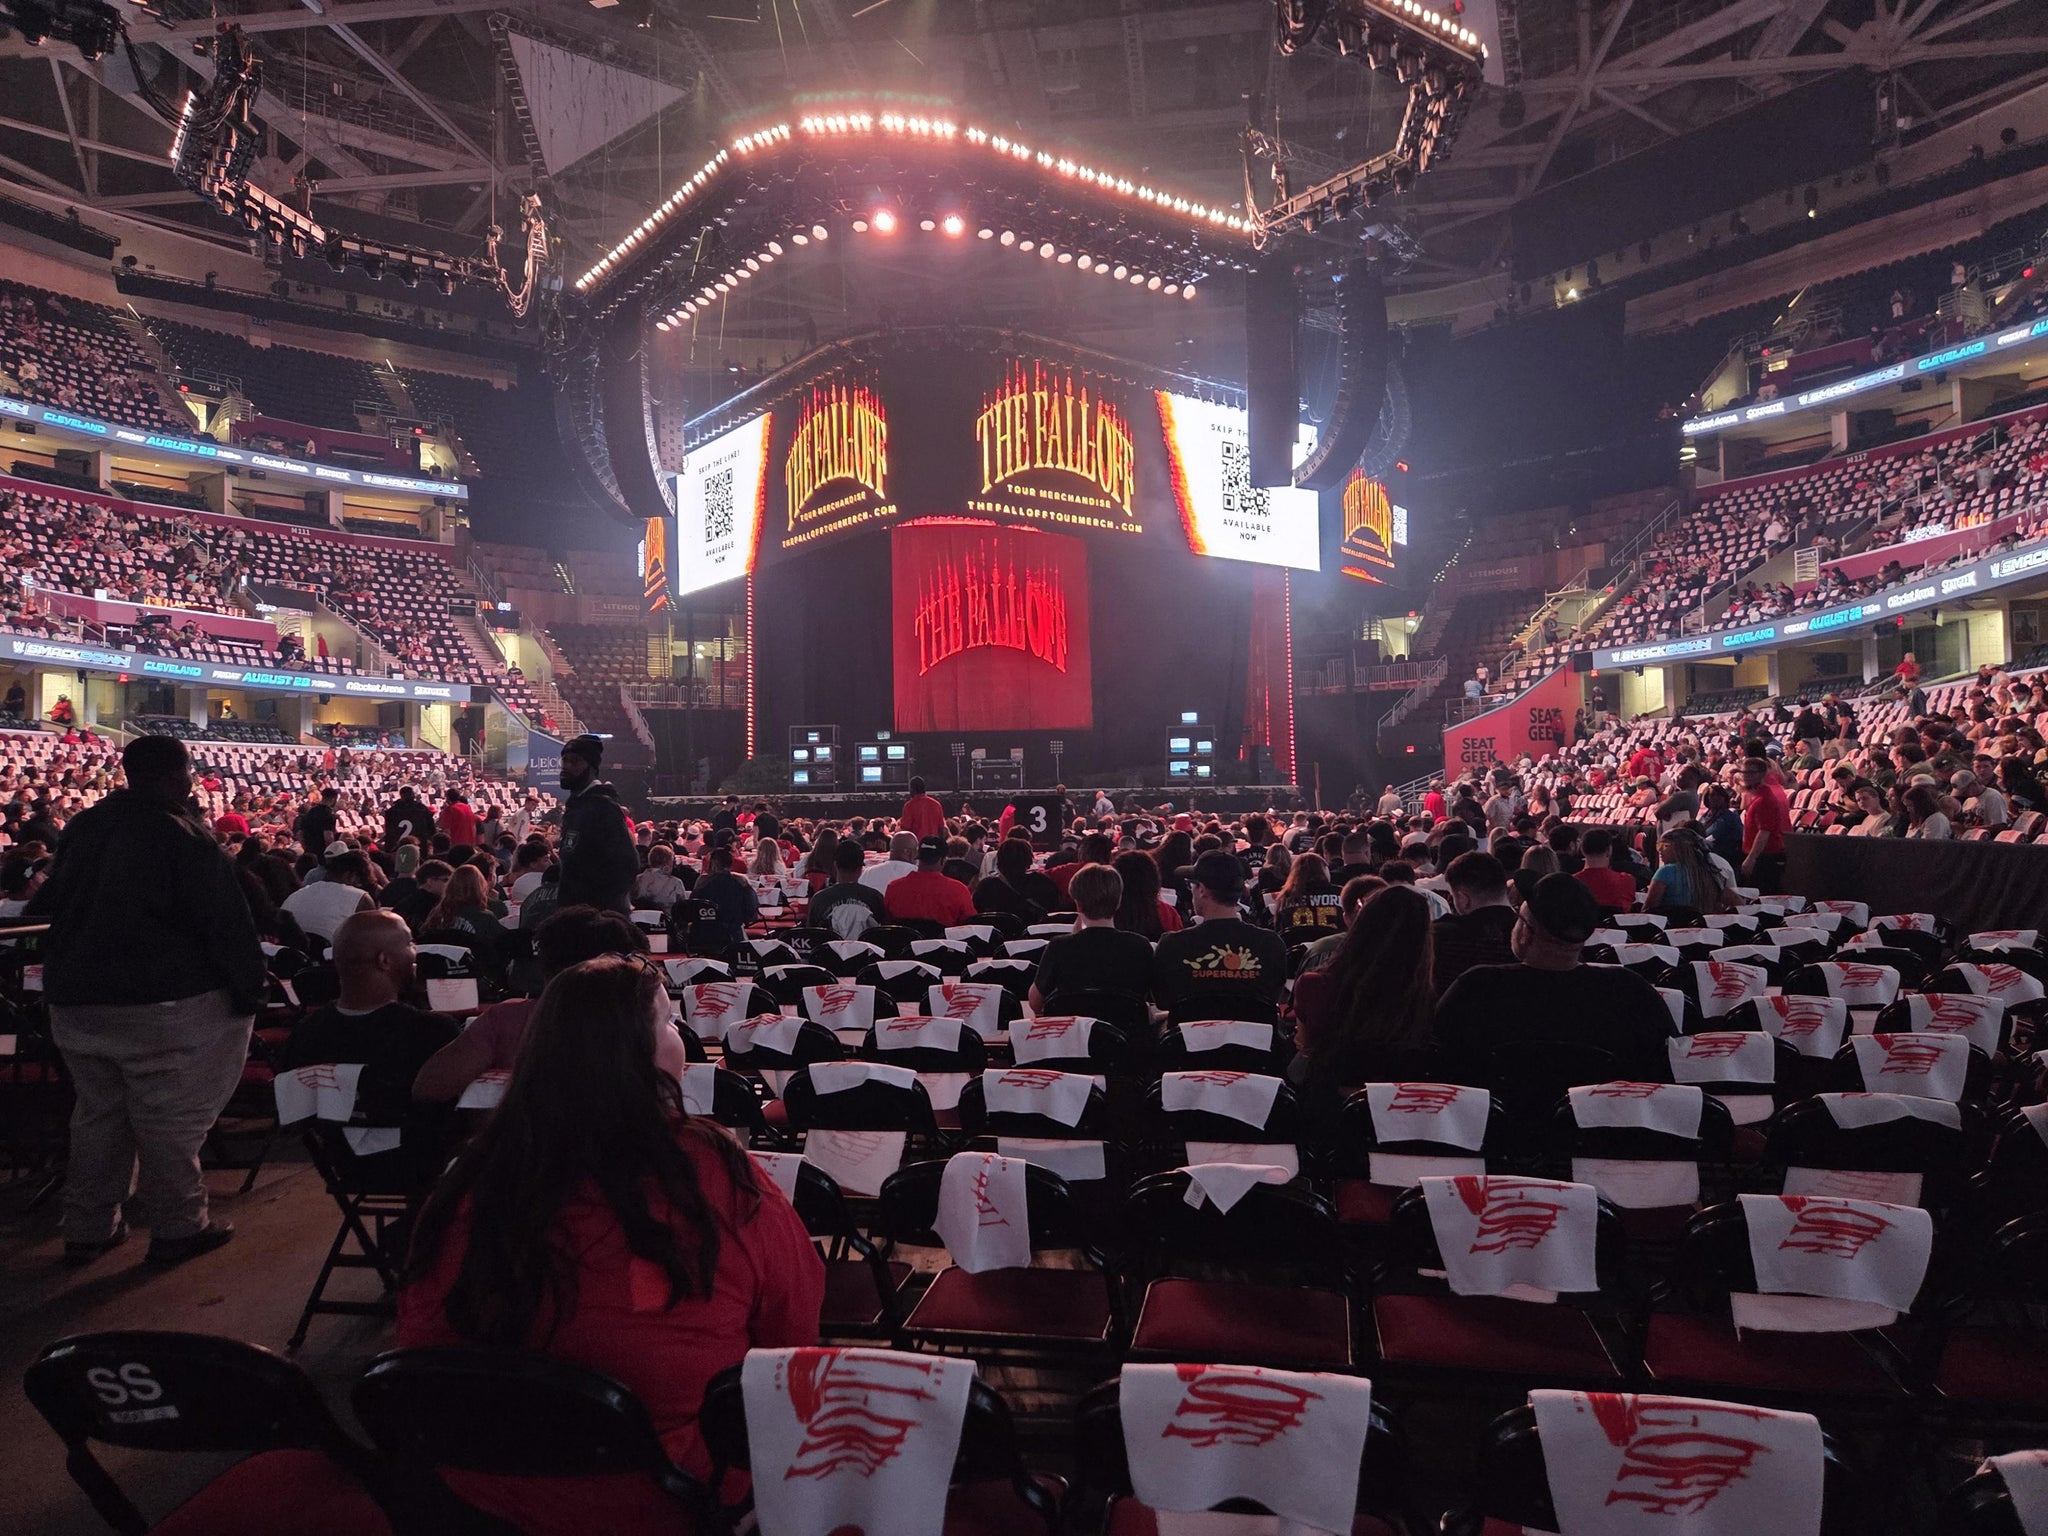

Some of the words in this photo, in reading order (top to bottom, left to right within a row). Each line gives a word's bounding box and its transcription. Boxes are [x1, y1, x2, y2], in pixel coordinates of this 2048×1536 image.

[43, 412, 107, 434] CLEVELAND
[1211, 423, 1233, 435] SKIP
[1237, 429, 1248, 438] TH
[146, 436, 198, 453] AUGUST
[976, 386, 1030, 494] THE
[713, 457, 723, 468] THE
[785, 415, 813, 531] THE
[1007, 483, 1036, 497] TOUR
[1039, 488, 1111, 509] MERCHANDISE
[1223, 518, 1271, 532] AVAILABLE
[1239, 532, 1257, 541] NOW
[705, 541, 735, 557] AVAILABLE
[1808, 609, 1849, 631] AUGUST
[1722, 627, 1776, 647] CLEVELAND
[25, 642, 131, 668] SMACKDOWN
[143, 661, 203, 678] CLEVELAND
[242, 672, 293, 686] AUGUST
[1528, 726, 1554, 742] GEE
[1462, 737, 1496, 750] SEAT
[1460, 750, 1497, 763] GEEK
[1029, 805, 1047, 833] 3
[398, 820, 414, 838] 2
[699, 907, 716, 917] GG
[791, 938, 812, 949] KK
[737, 952, 757, 965] LL
[87, 1362, 163, 1404] SS
